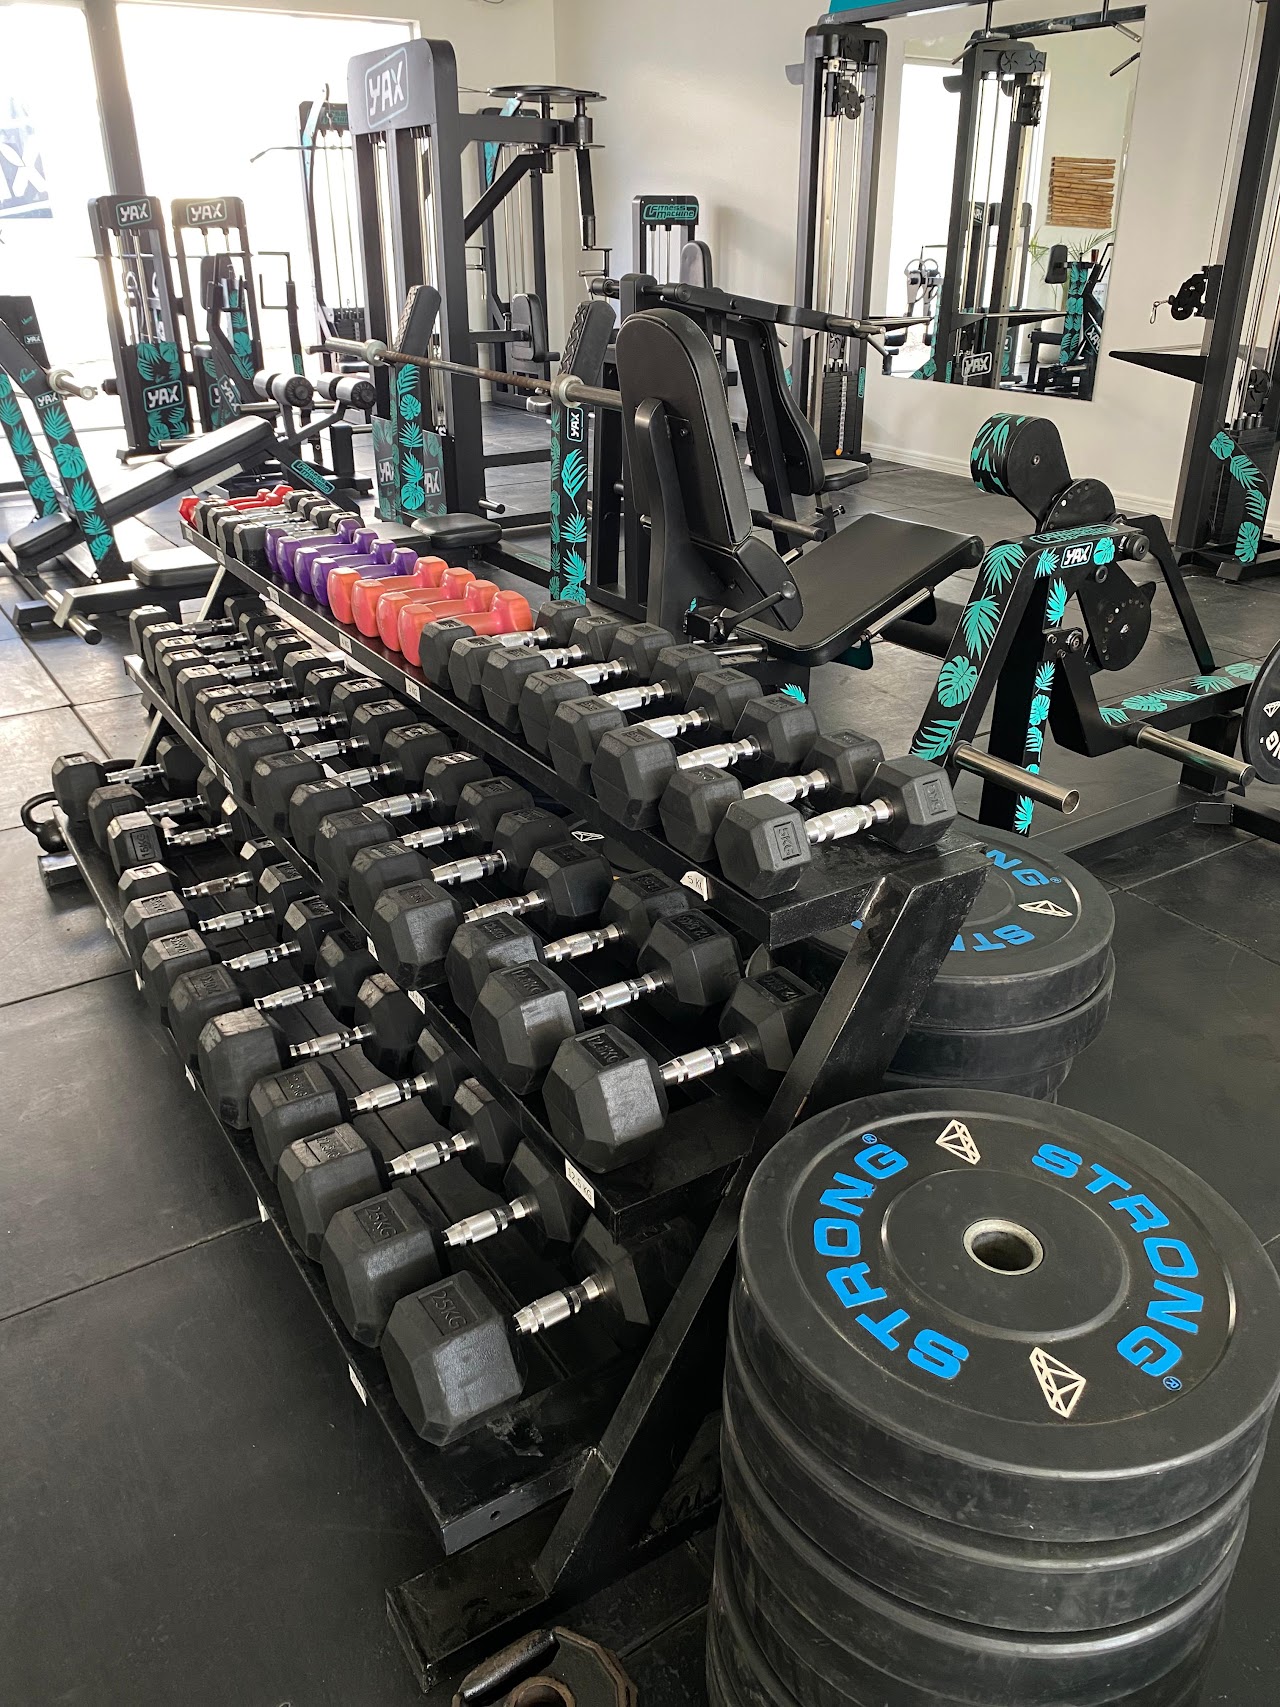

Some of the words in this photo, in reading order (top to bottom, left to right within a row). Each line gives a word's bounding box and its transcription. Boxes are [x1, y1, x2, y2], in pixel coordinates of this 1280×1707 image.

[369, 61, 404, 116] YAX
[120, 203, 149, 222] YAX
[191, 203, 223, 222] YAX
[26, 335, 41, 343] YAX
[37, 392, 59, 407] YAX
[147, 385, 179, 408] YAX
[570, 411, 580, 438] YAX
[425, 470, 441, 494] AX
[1064, 545, 1091, 566] YAX
[137, 833, 150, 858] 15KG
[365, 1206, 398, 1238] 25KG
[432, 1290, 468, 1329] 25KG
